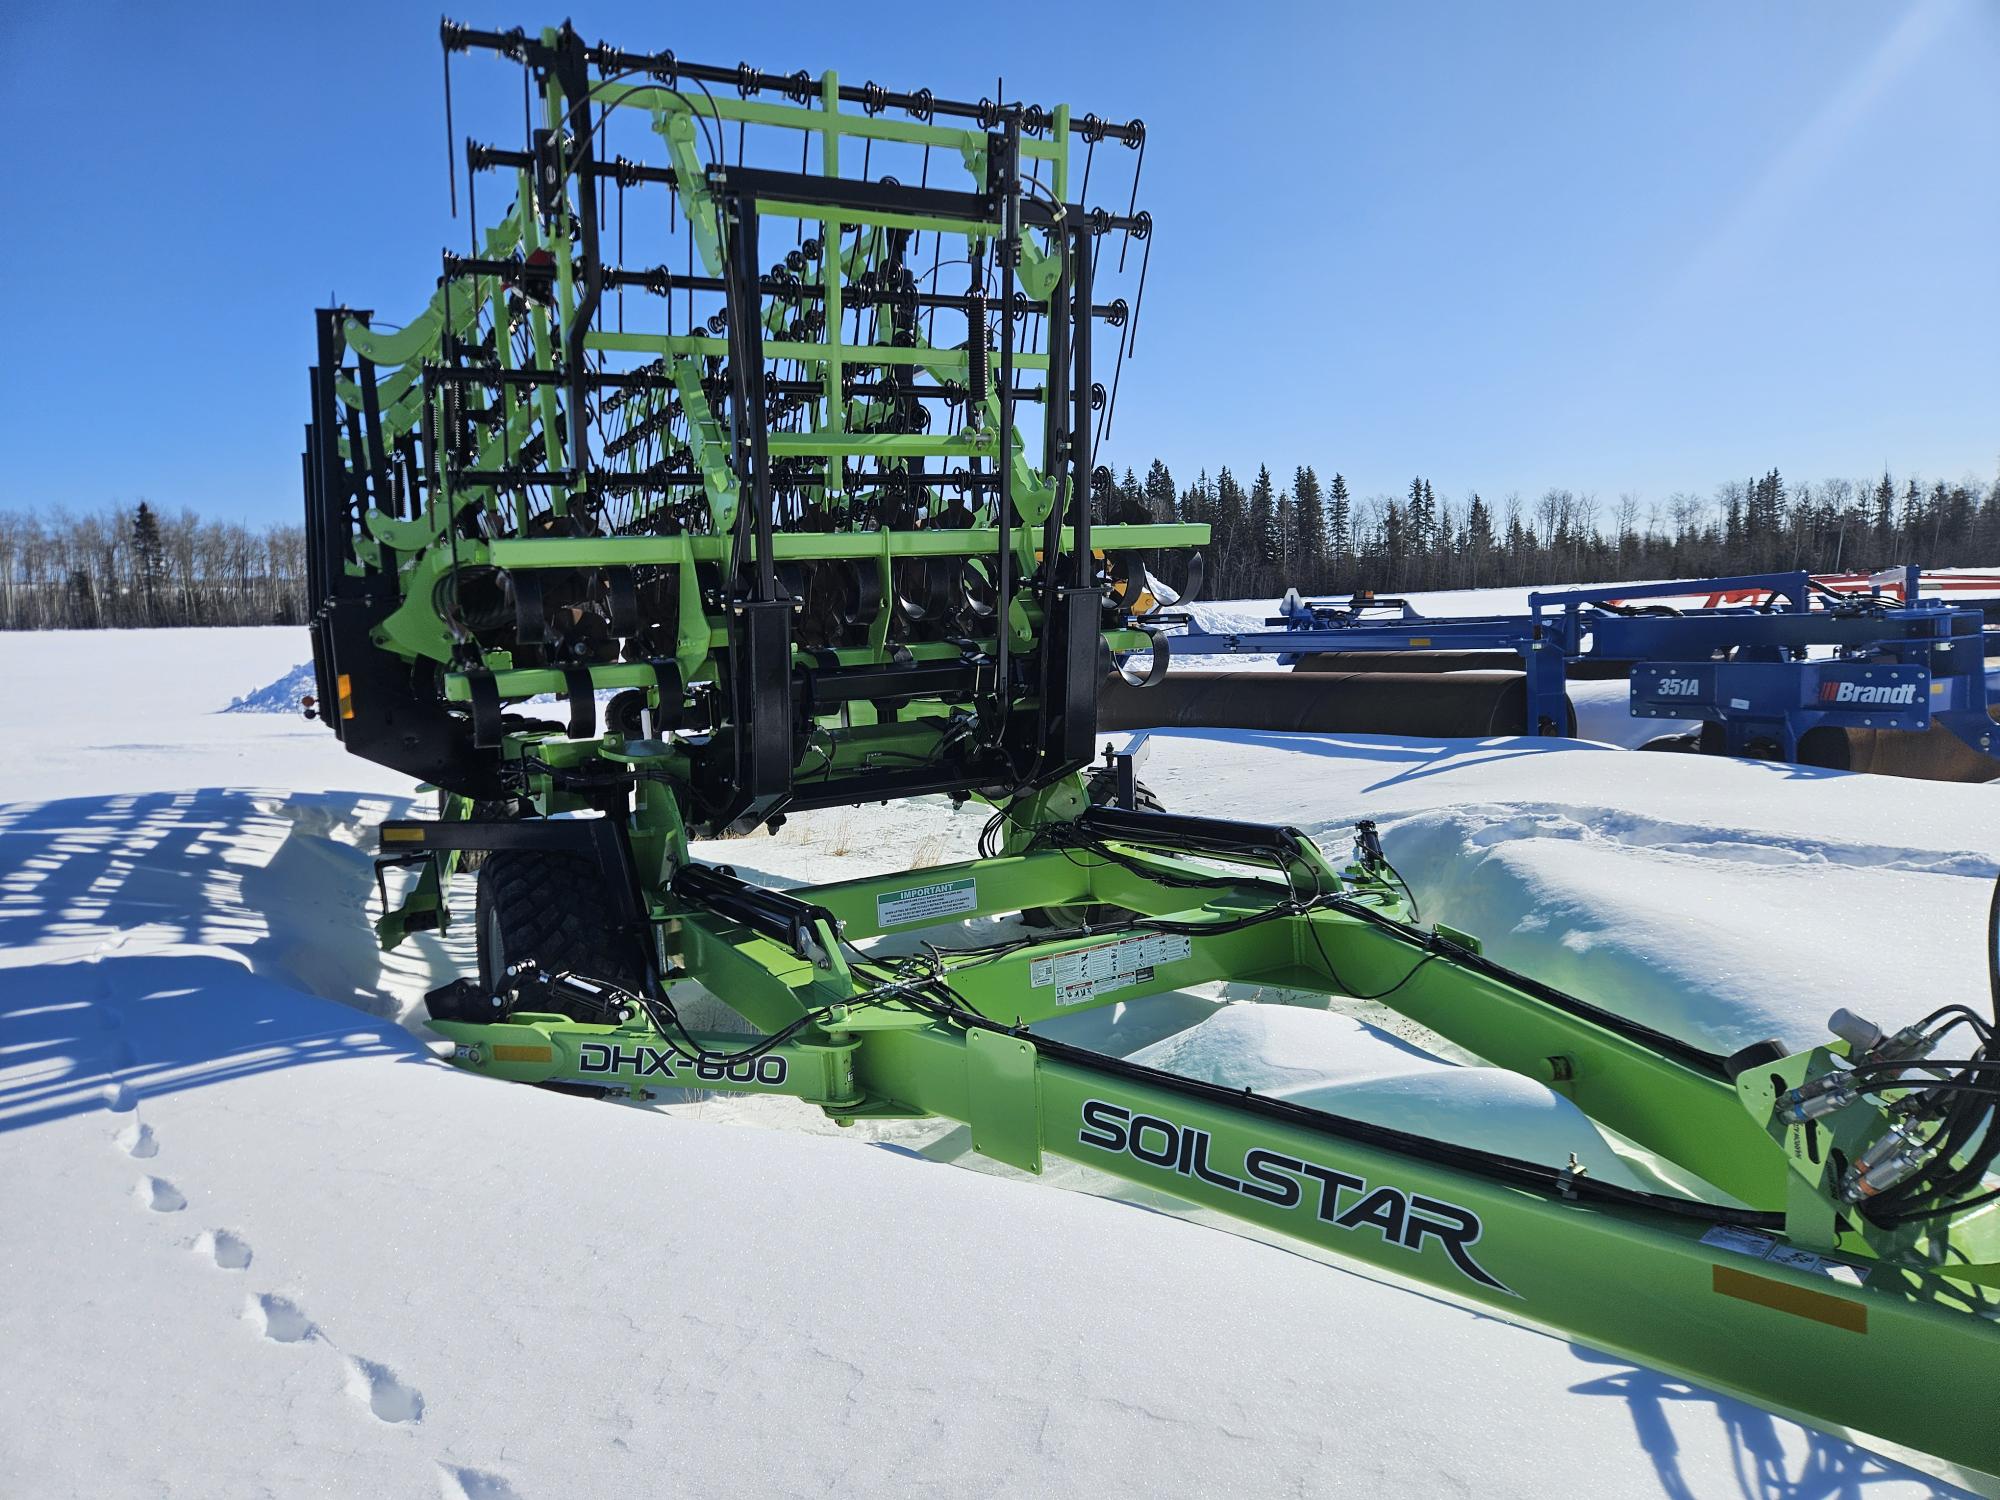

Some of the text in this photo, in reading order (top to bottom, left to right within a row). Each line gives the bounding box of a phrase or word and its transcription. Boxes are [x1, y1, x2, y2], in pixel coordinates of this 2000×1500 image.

[1658, 678, 1699, 696] 351A
[1836, 682, 1916, 704] Brandt
[900, 884, 953, 900] IMPORTANT
[579, 1042, 788, 1085] DHX-600
[1079, 1099, 1527, 1301] SOILSTAR
